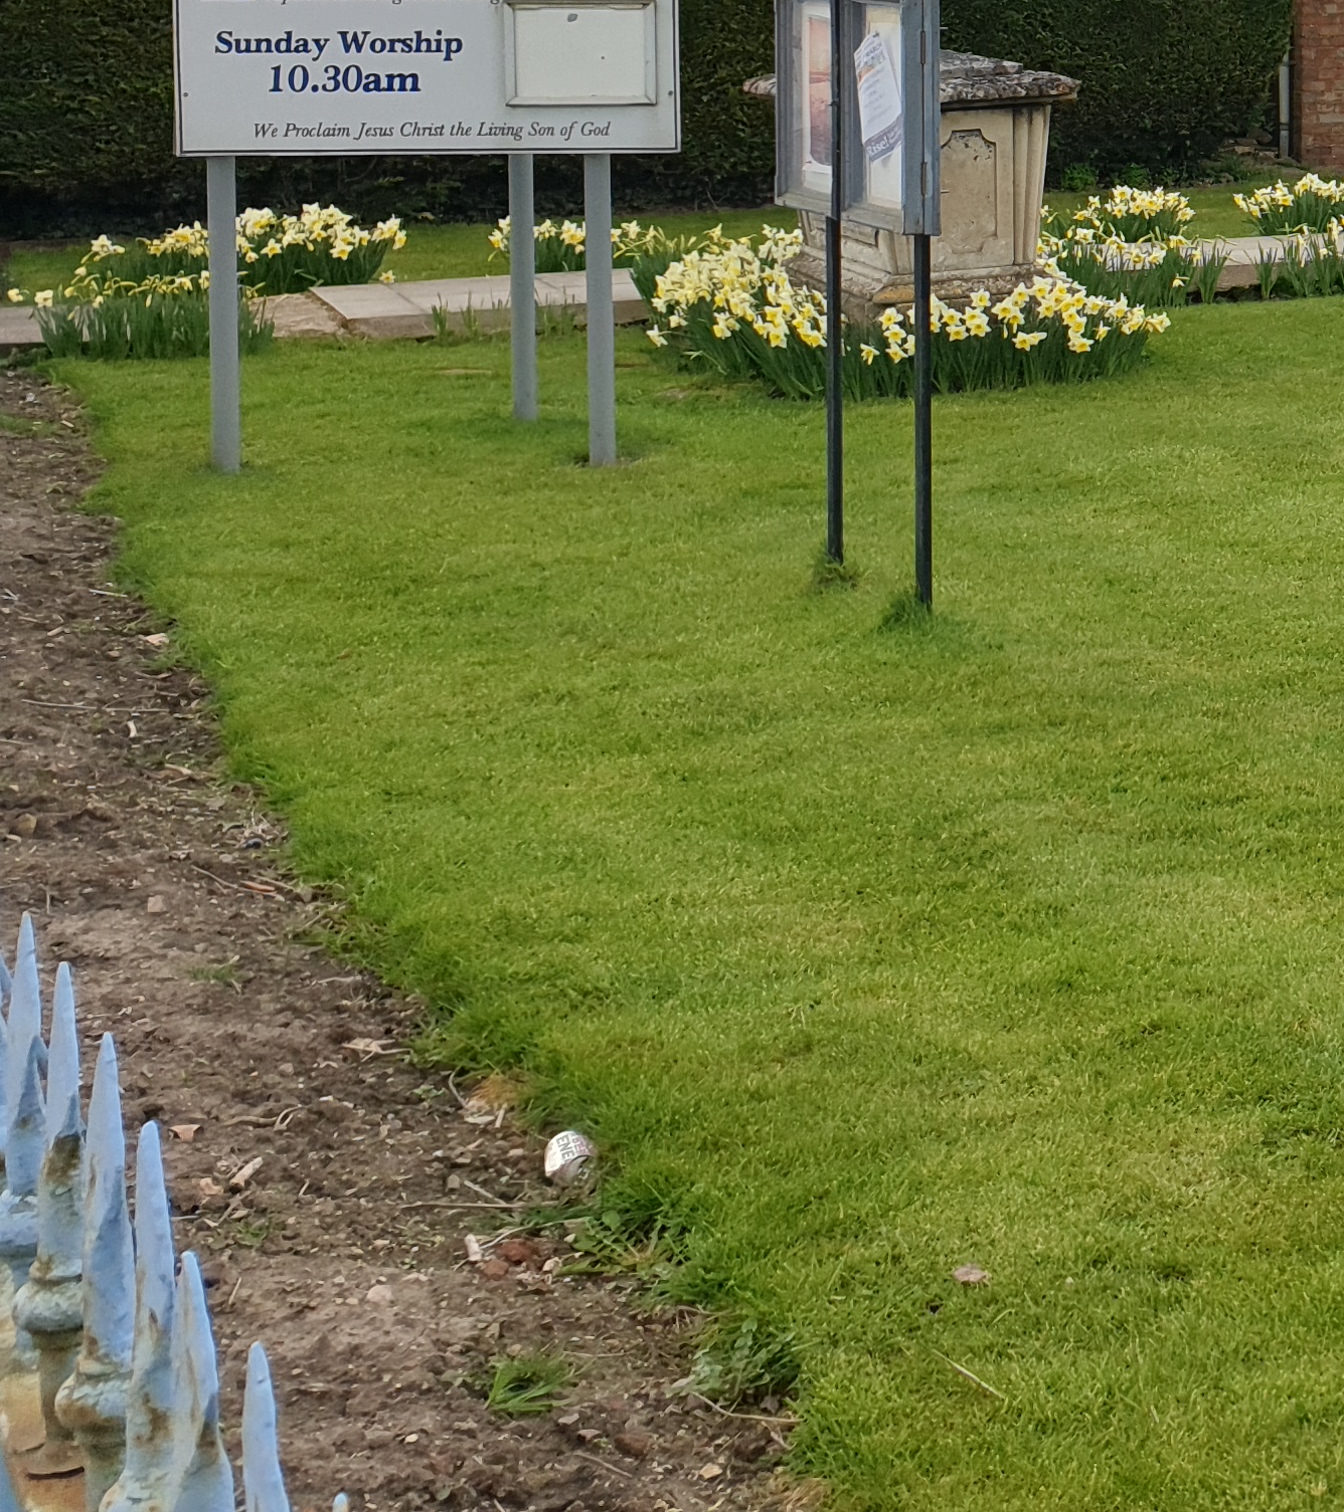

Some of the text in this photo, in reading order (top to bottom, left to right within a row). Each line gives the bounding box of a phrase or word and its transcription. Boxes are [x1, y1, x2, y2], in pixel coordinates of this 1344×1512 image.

[214, 29, 463, 61] Sunday Worship
[268, 64, 422, 93] 10.30am
[254, 121, 611, 141] We Proclaim Jesus Christ the Living Son of God
[866, 135, 890, 156] Rise!
